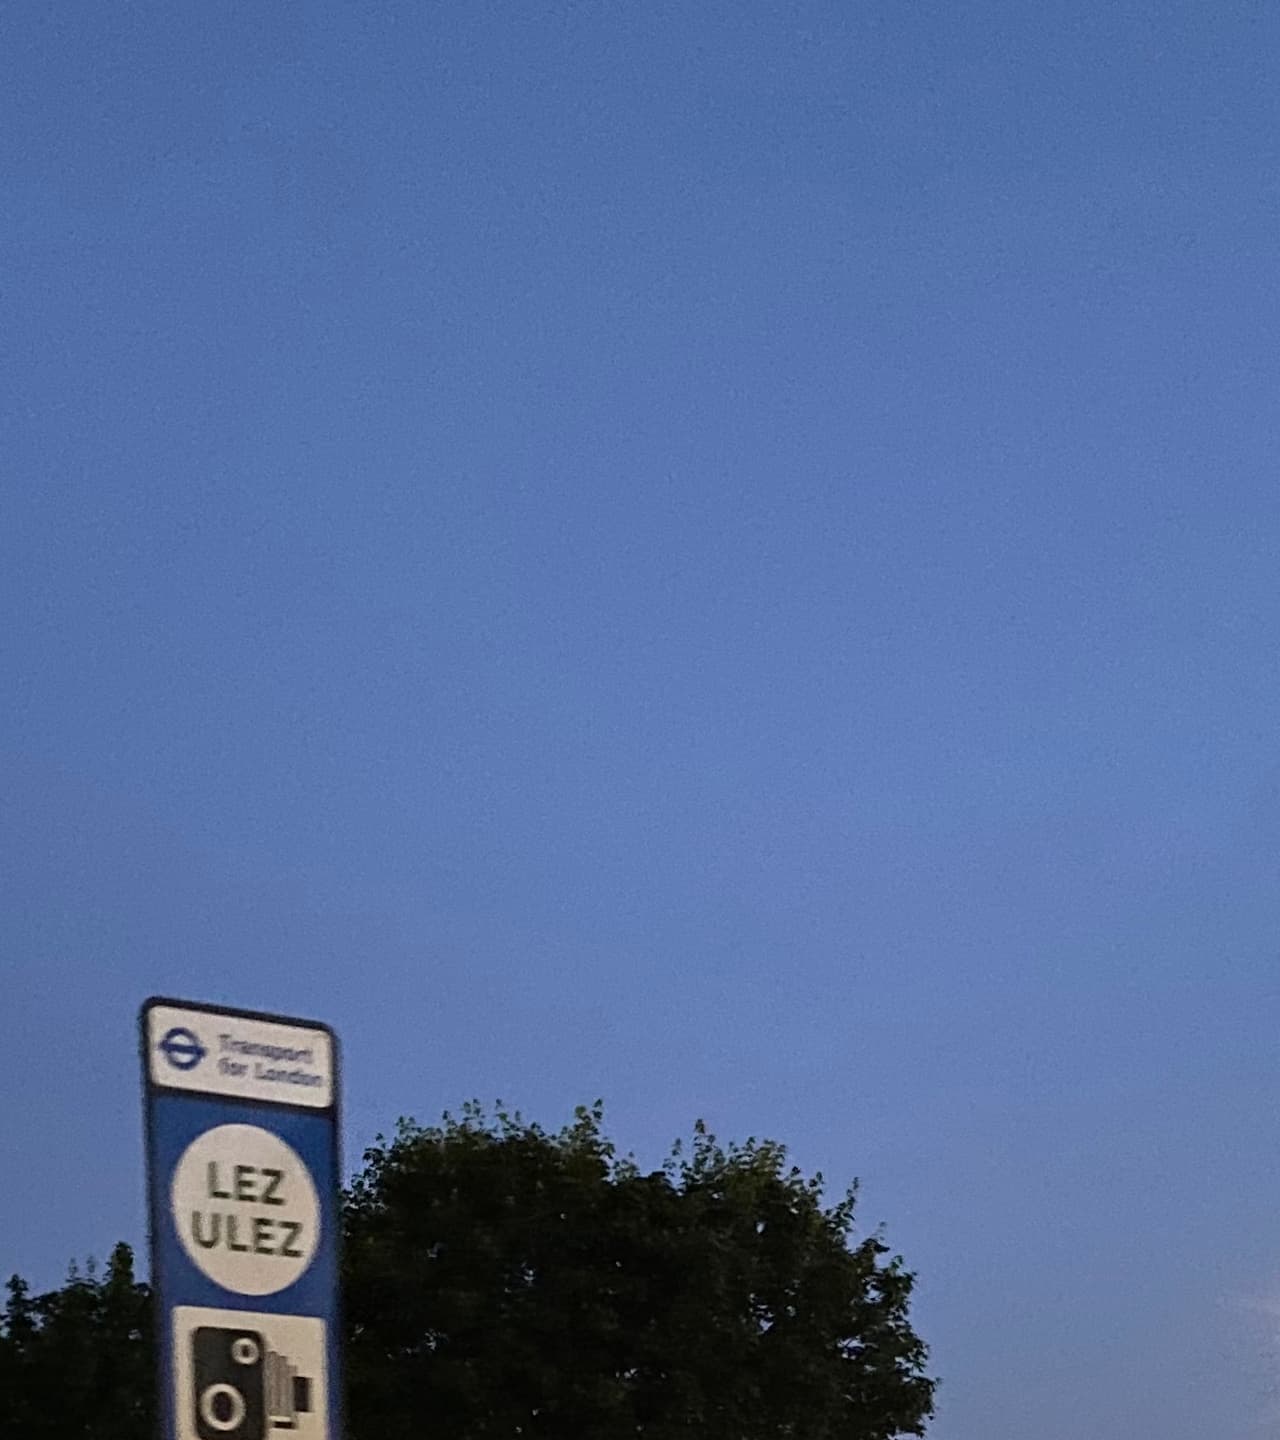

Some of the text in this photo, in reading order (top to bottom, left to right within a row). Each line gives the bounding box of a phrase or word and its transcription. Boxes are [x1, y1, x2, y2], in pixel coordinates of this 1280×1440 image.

[218, 1034, 314, 1063] Transport
[219, 1057, 321, 1087] for London
[207, 1161, 286, 1205] LEZ
[192, 1211, 303, 1258] ULEZ
